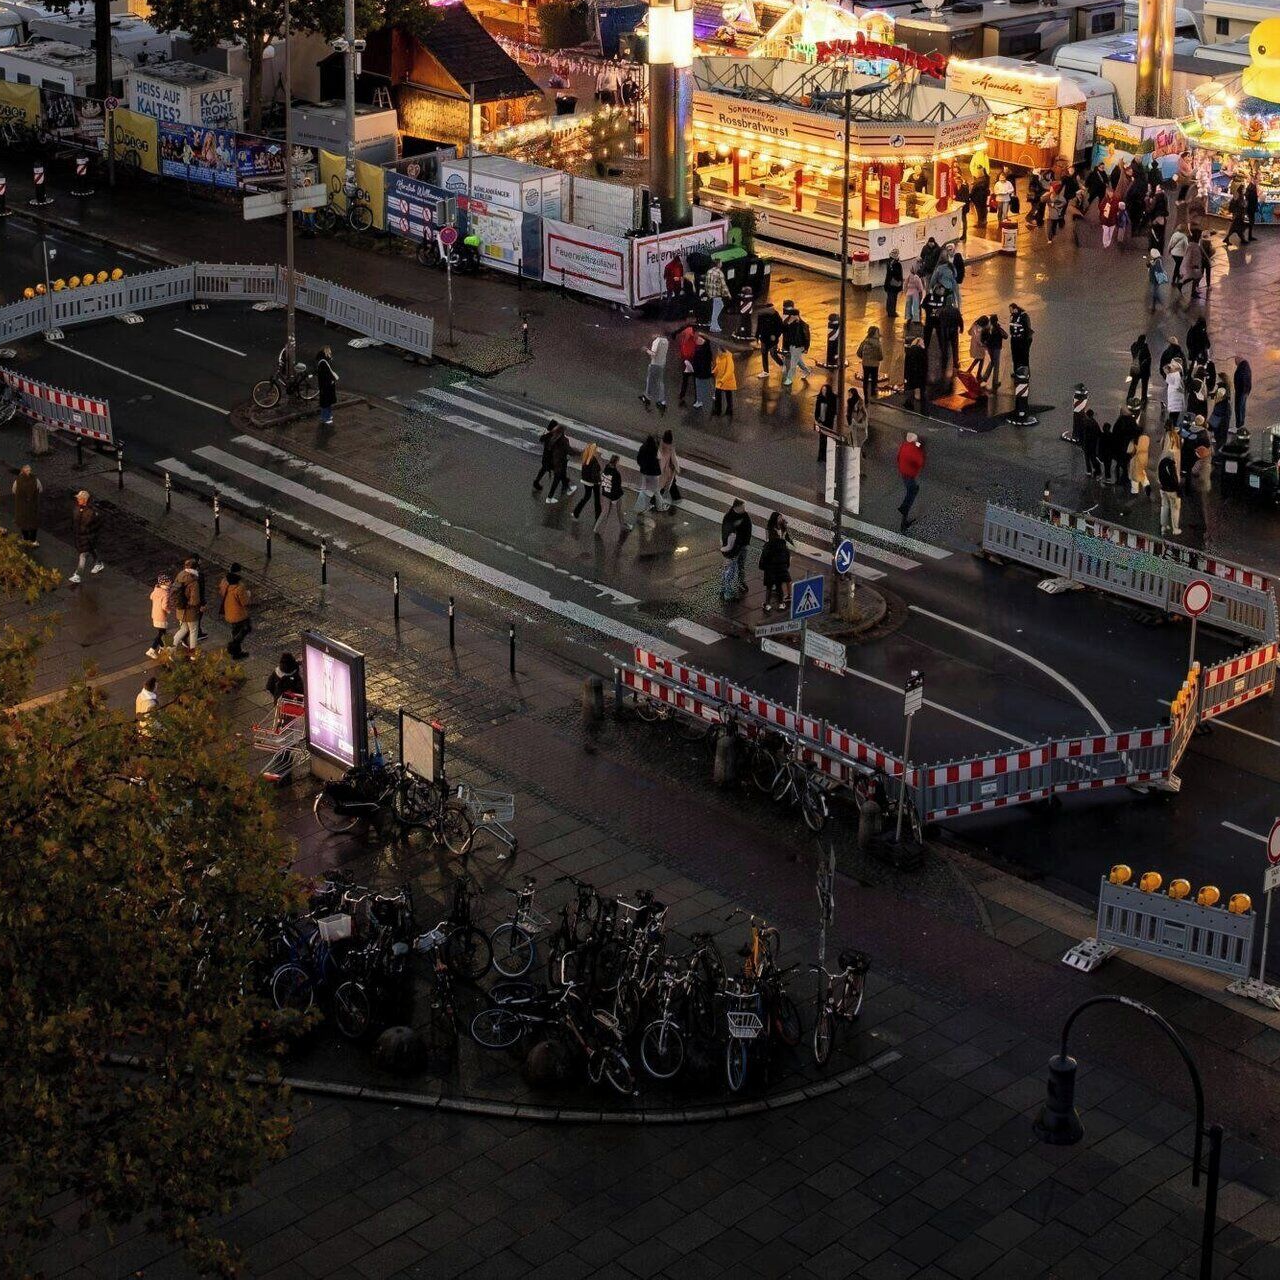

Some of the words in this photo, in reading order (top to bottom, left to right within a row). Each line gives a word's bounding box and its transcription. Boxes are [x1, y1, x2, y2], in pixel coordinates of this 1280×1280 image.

[136, 80, 161, 98] HEISS
[162, 89, 181, 106] AUF
[972, 73, 1023, 95] Mandeln
[137, 96, 181, 121] KALTES?
[201, 87, 233, 107] KALT
[201, 102, 234, 117] FRONT
[718, 113, 789, 137] Rossbratwurst
[554, 246, 619, 270] Feuerwehrzufahrt
